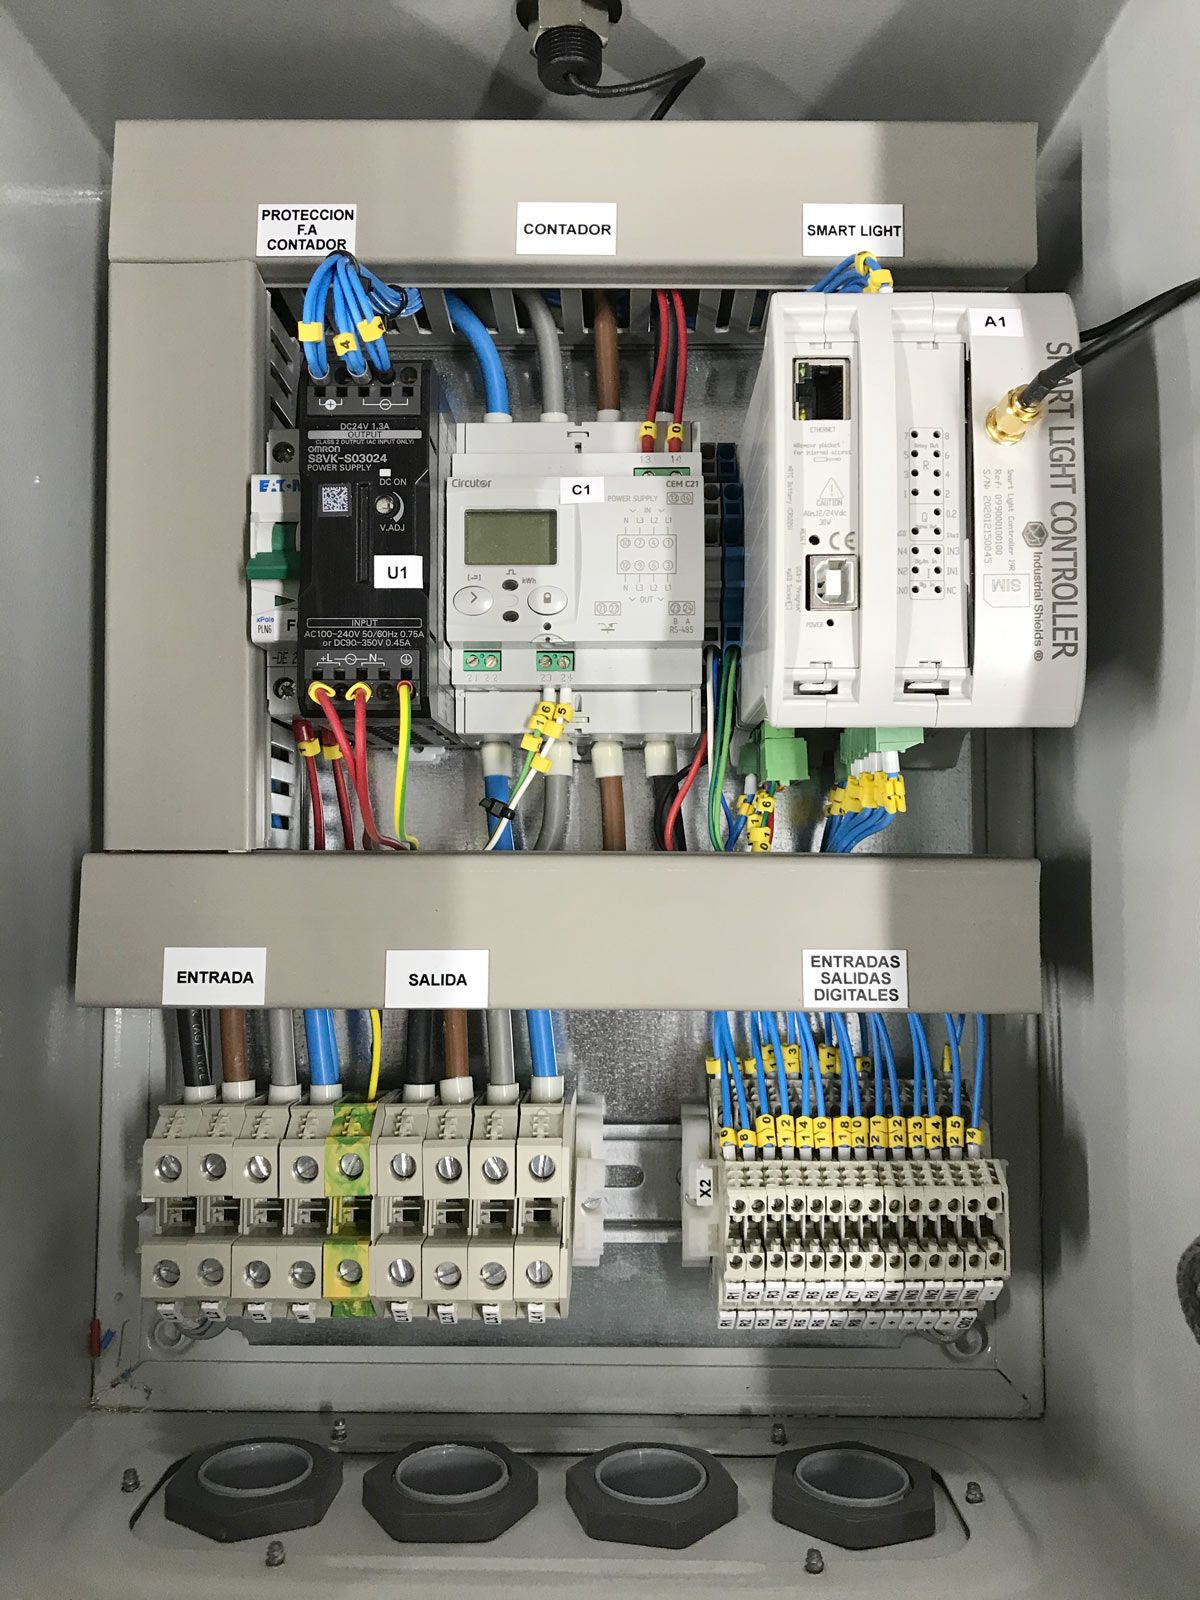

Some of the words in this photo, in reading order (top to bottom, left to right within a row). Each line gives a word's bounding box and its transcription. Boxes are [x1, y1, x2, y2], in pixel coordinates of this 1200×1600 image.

[262, 209, 354, 221] PROTECCION
[298, 224, 317, 236] F.A
[523, 223, 611, 236] CONTADOR
[807, 225, 856, 236] SMART
[860, 225, 902, 237] LIGHT
[267, 239, 346, 251] CONTADOR
[984, 316, 1006, 328] A1
[1045, 342, 1075, 419] SRT
[308, 454, 388, 463] S8VK-S03024
[1049, 426, 1077, 494] LIGHT
[339, 464, 372, 472] SUPPLY
[380, 478, 392, 486] DC
[394, 478, 407, 486] ON
[451, 479, 492, 488] Circutor
[572, 485, 590, 495] C1
[387, 566, 407, 579] U1
[1033, 552, 1043, 601] Industrial
[1050, 501, 1079, 660] CONTROLLER
[1034, 604, 1043, 647] Shields
[334, 639, 383, 647] DC90-350V
[385, 639, 411, 647] 0.45A
[811, 955, 900, 968] ENTRADAS
[177, 971, 254, 984] ENTRADA
[408, 973, 467, 986] SALIDA
[821, 972, 891, 985] SALIDAS
[814, 988, 899, 1001] DIGITALES
[700, 1179, 712, 1198] X2
[747, 1291, 760, 1299] R2
[767, 1290, 780, 1299] R3
[787, 1290, 800, 1299] R4
